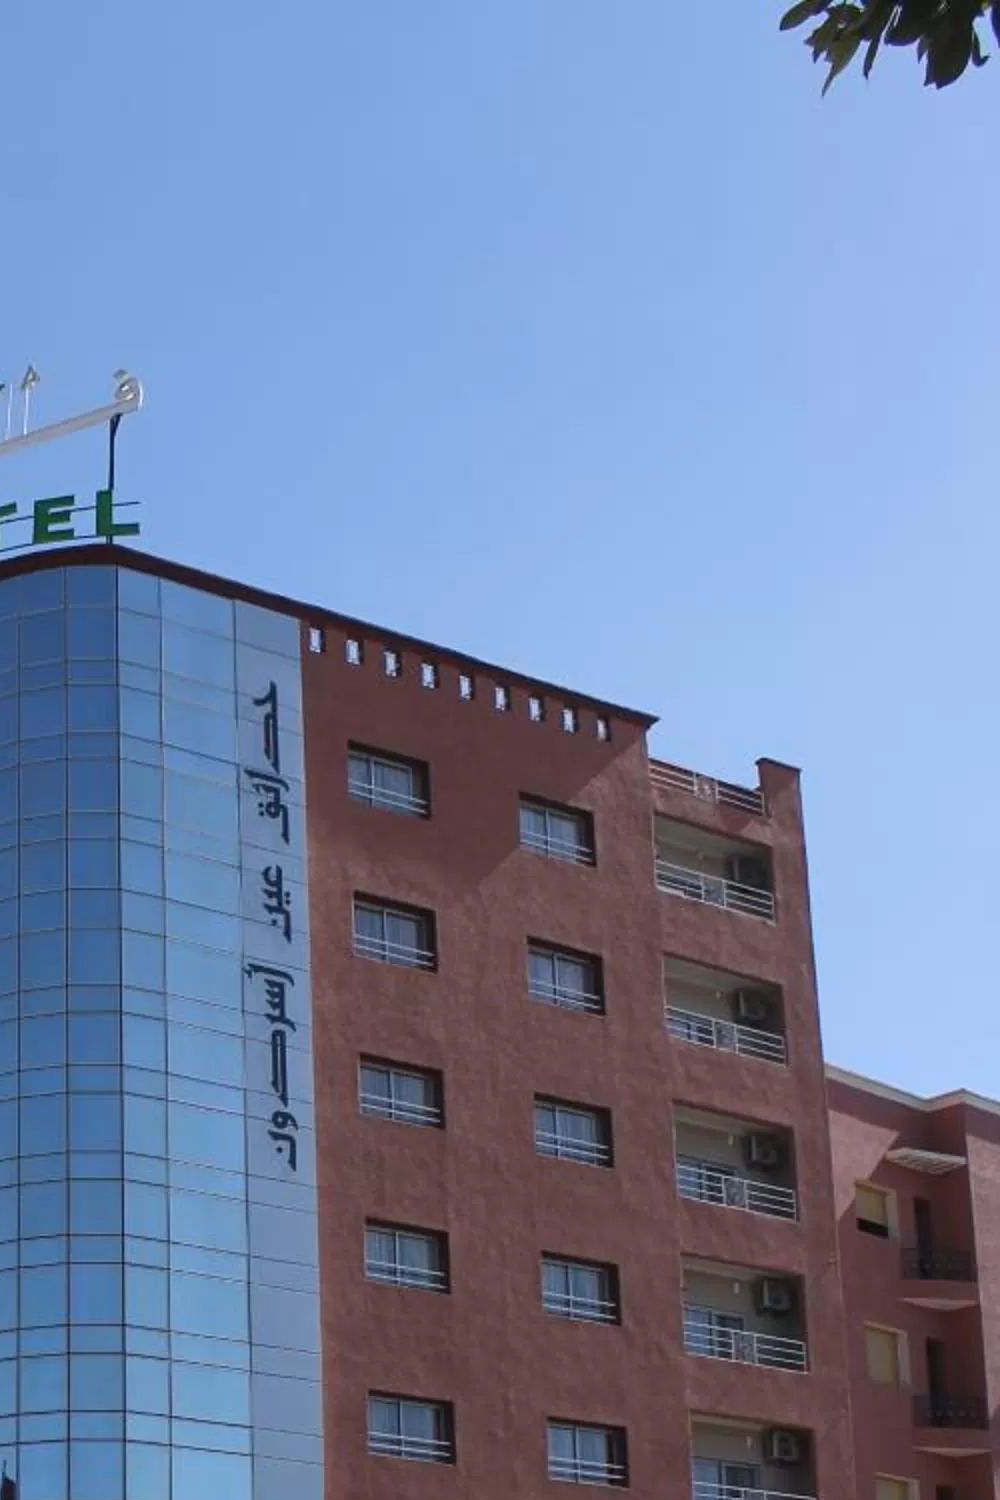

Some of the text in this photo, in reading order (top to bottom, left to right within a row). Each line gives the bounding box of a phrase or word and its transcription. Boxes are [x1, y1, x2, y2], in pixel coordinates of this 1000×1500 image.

[243, 680, 297, 1173] حدائق عين أسردون
